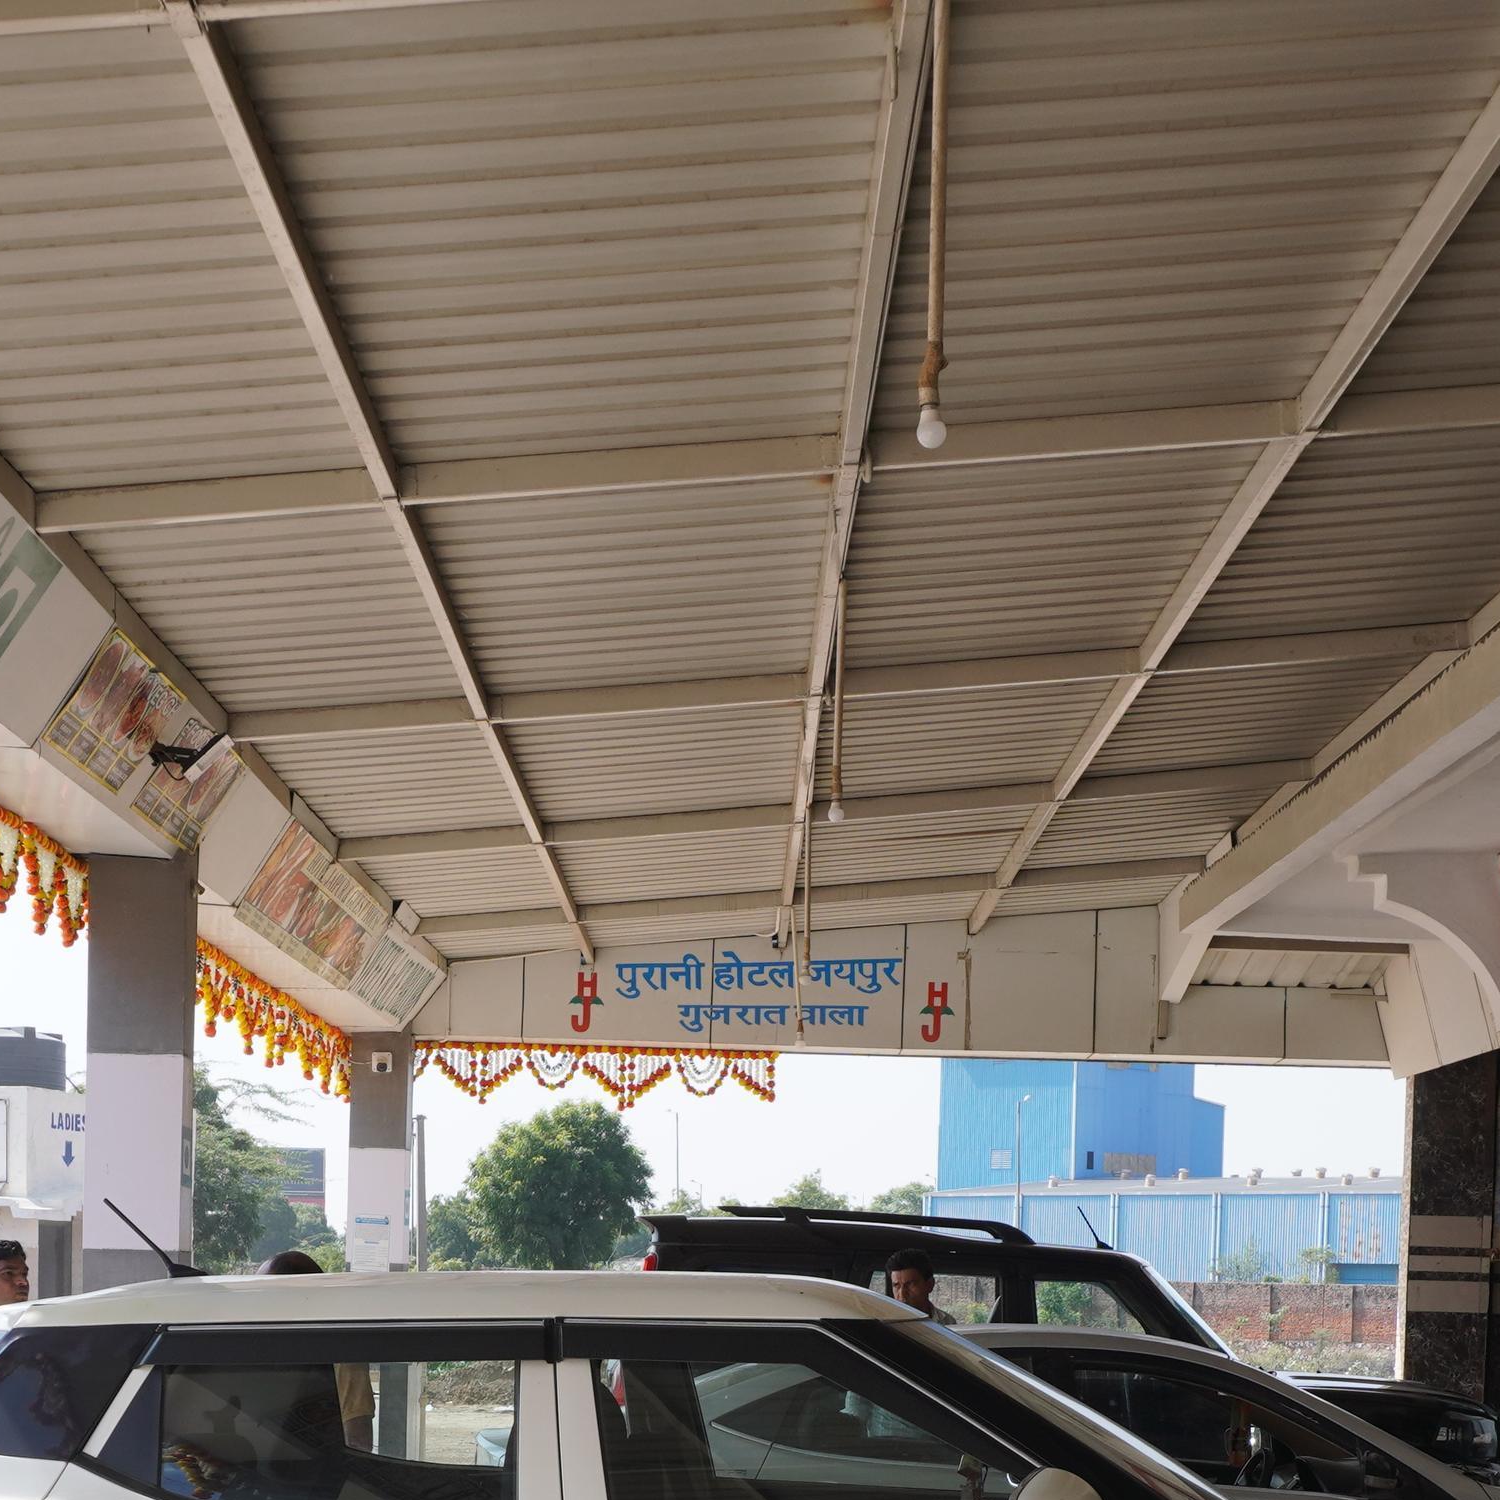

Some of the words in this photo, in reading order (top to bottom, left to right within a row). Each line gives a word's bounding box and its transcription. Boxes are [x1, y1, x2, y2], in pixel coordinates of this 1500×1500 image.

[615, 953, 705, 998] पुरानी
[711, 950, 794, 991] होटल
[807, 958, 902, 994] जयपुर
[678, 1004, 790, 1033] गुजरात
